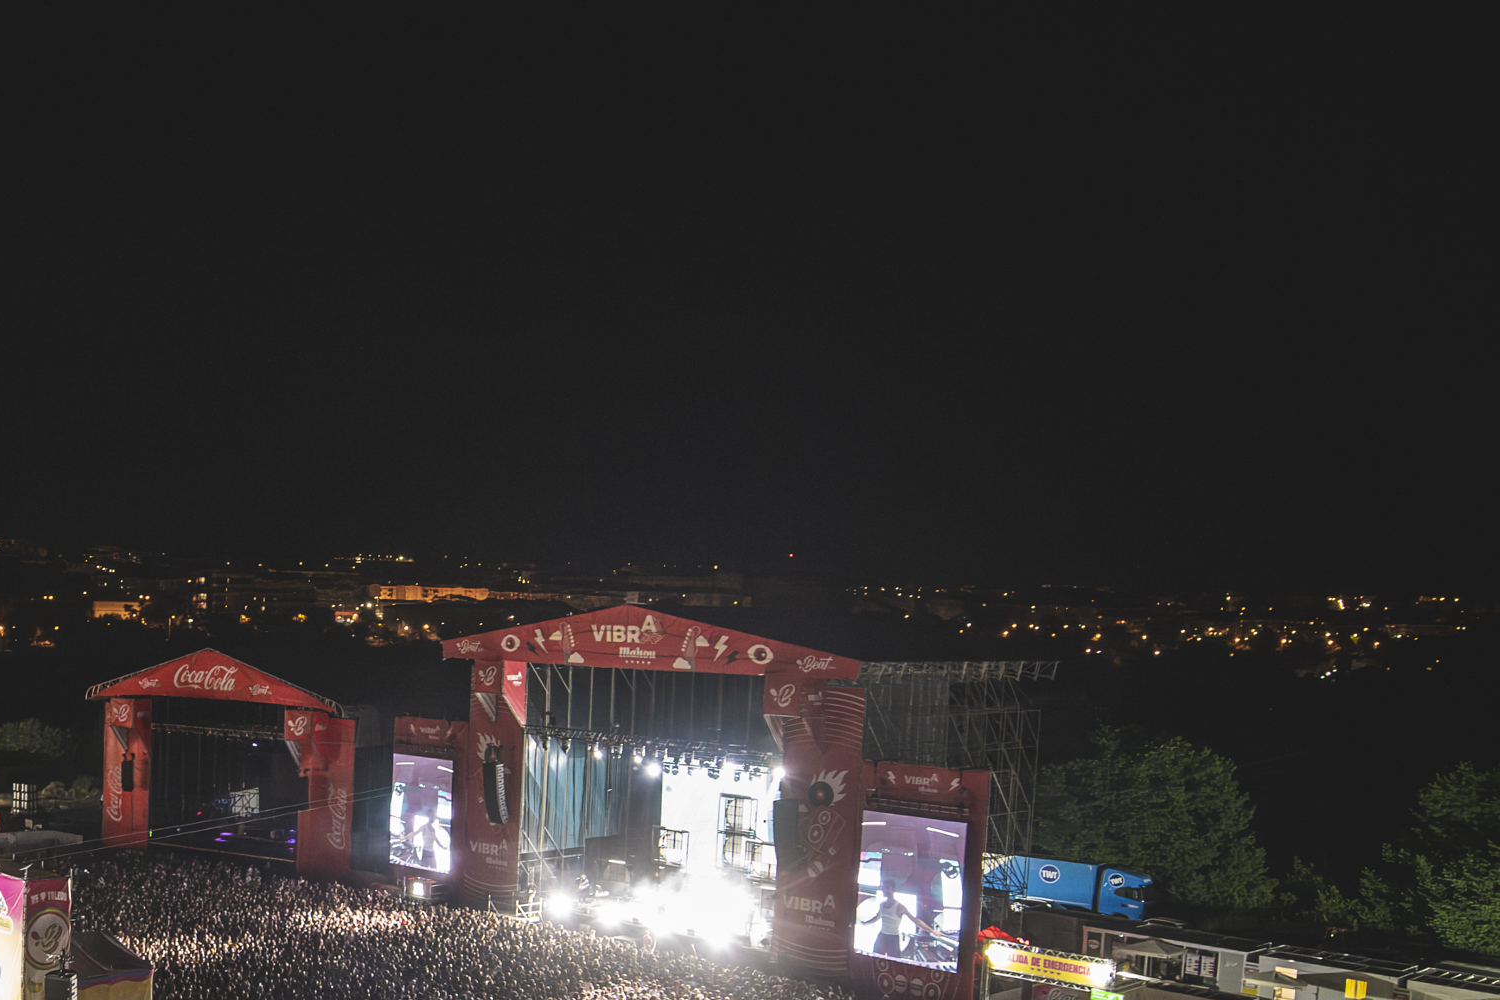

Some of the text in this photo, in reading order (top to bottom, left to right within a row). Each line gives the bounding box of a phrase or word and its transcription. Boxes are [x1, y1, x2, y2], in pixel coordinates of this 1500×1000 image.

[591, 615, 658, 643] VIBRA
[904, 774, 939, 788] VIBRA
[783, 894, 835, 914] VIBRA
